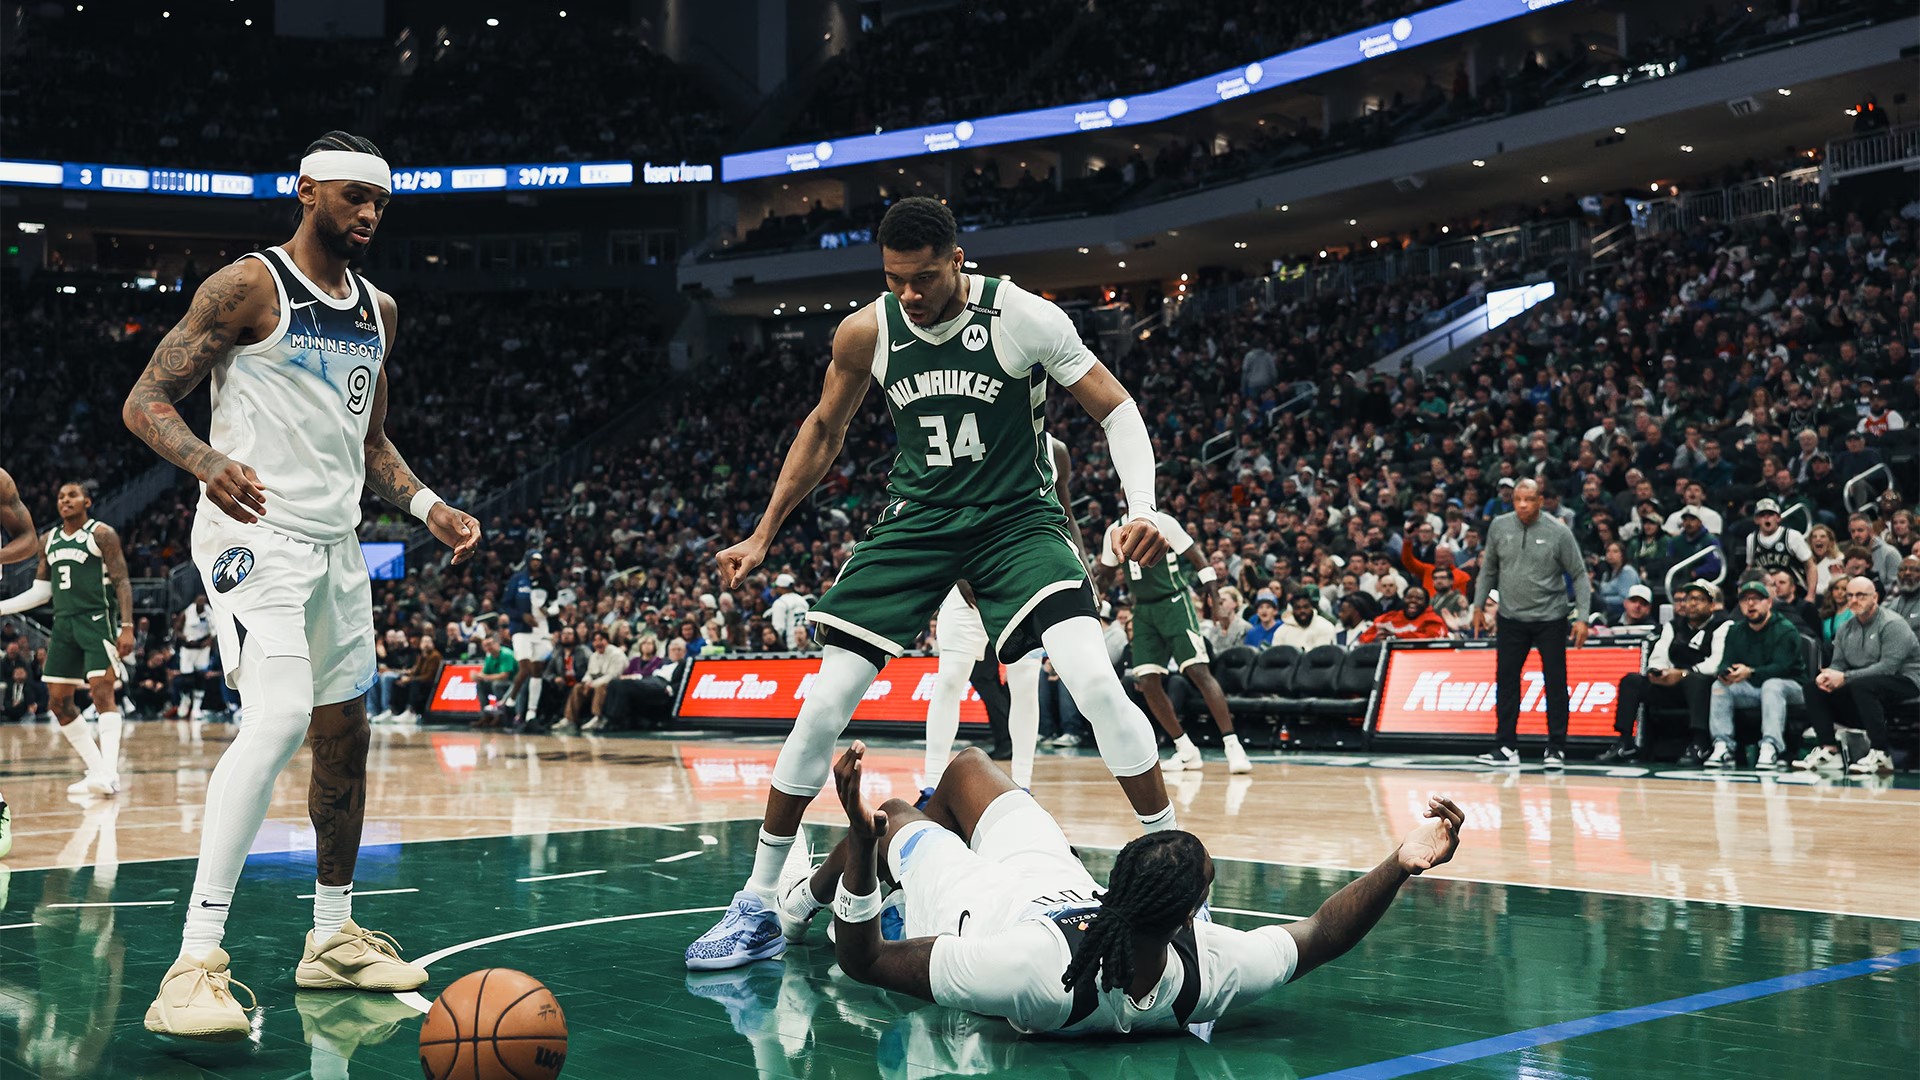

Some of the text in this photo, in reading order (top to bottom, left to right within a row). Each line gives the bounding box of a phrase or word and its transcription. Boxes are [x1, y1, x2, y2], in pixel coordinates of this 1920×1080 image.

[391, 171, 442, 190] 12/30
[518, 167, 570, 186] 39/77
[354, 320, 378, 333] sezzle
[290, 334, 382, 361] MINNESOTA
[346, 365, 372, 415] 9
[887, 370, 1004, 410] MILWAUKEE
[918, 412, 986, 467] 34
[57, 565, 71, 590] 3
[1060, 912, 1098, 925] sezzle
